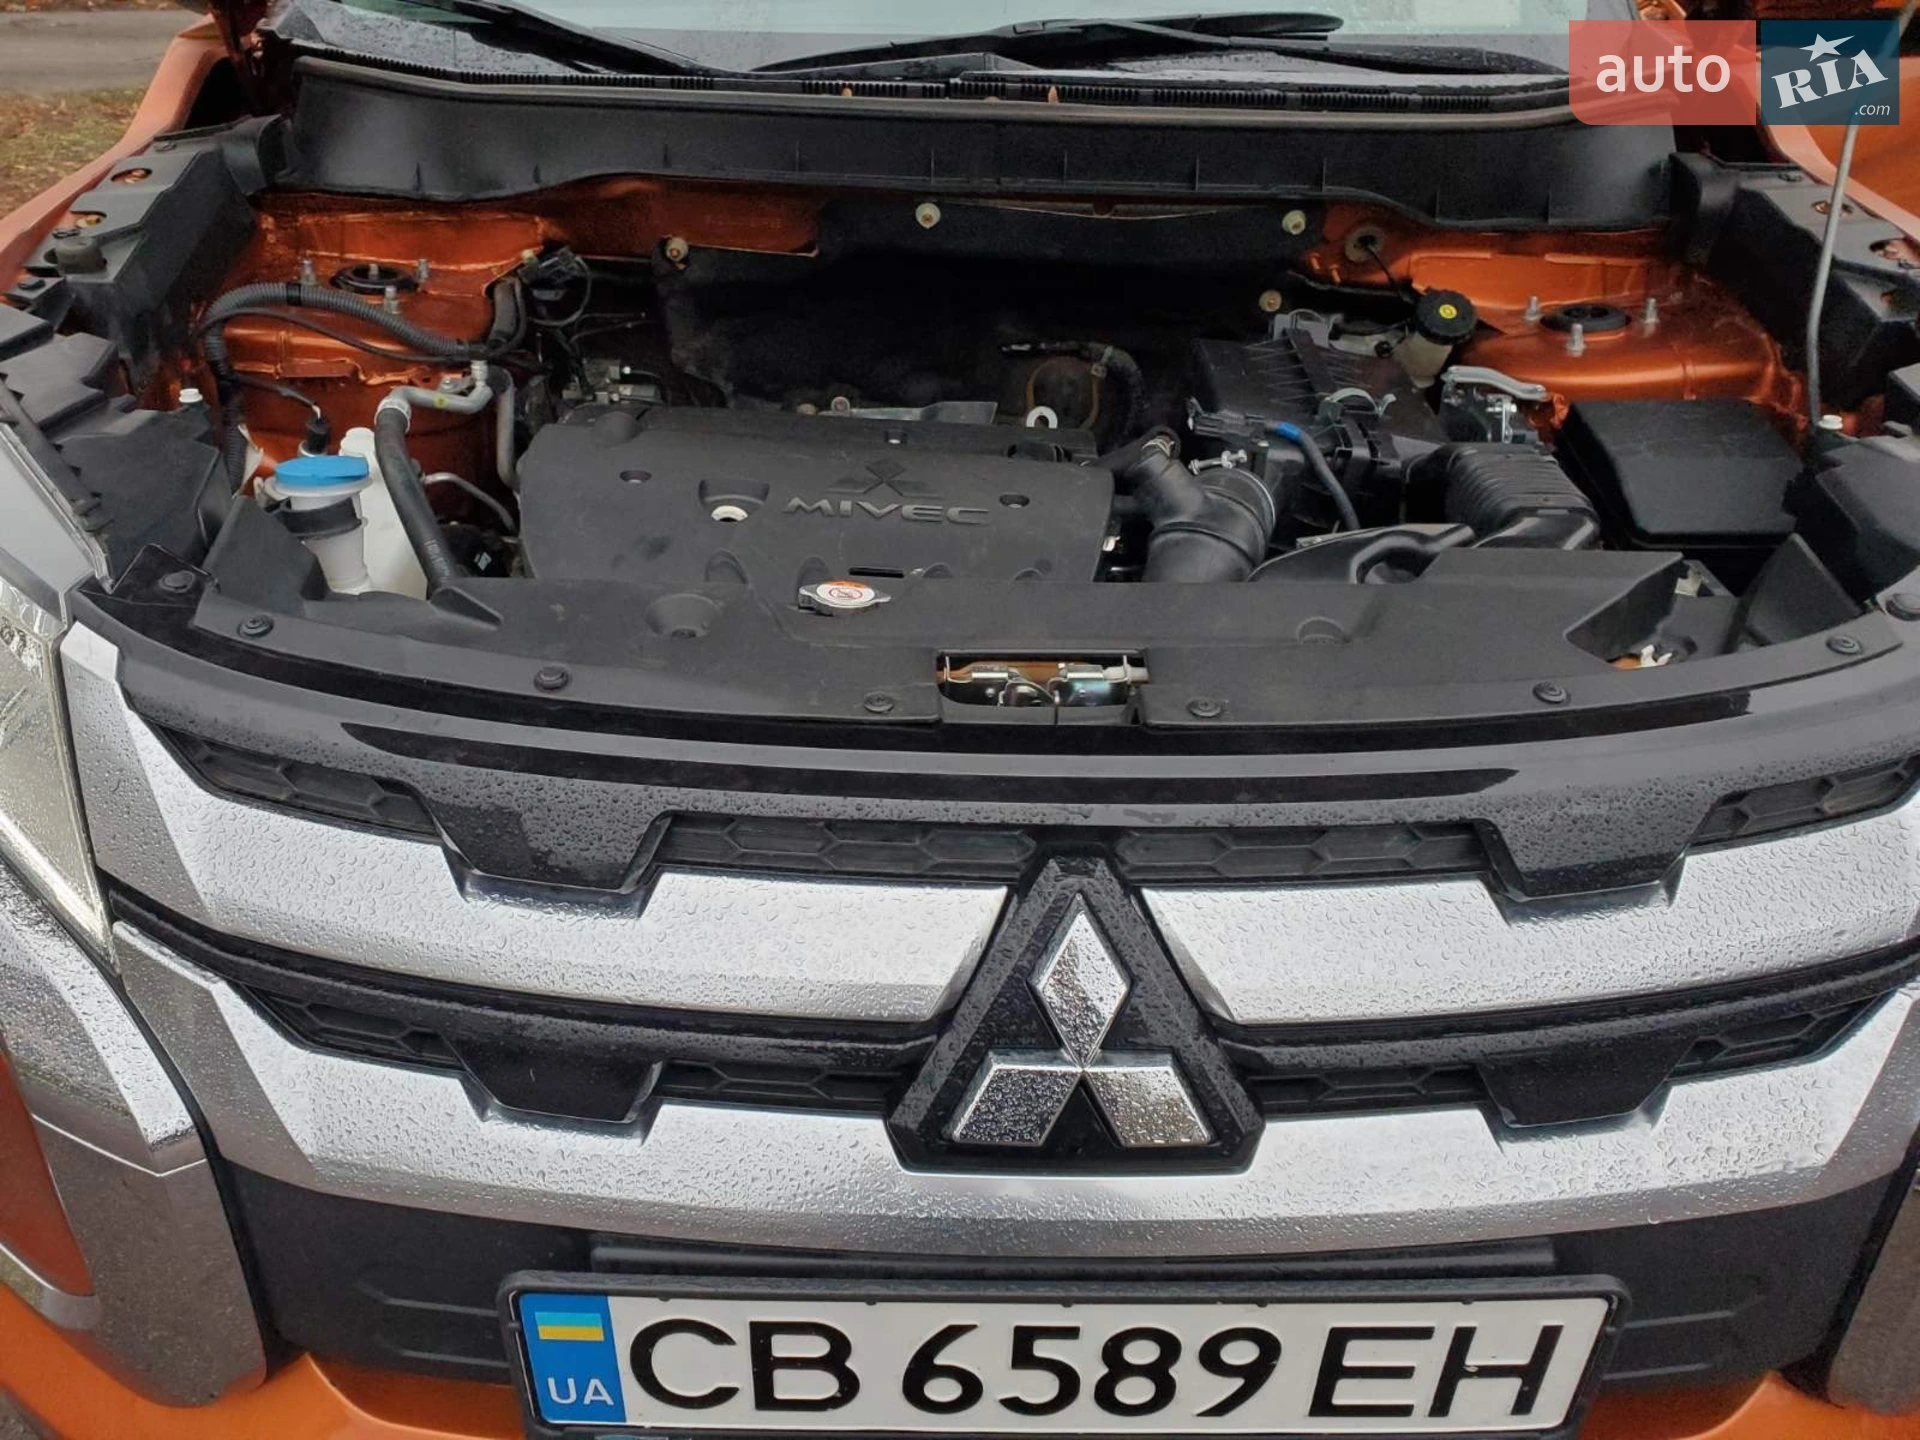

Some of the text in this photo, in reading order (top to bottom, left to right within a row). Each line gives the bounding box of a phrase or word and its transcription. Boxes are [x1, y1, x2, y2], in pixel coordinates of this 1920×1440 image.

[782, 497, 990, 525] MIVEC
[629, 1317, 1565, 1418] CB 6589 EH
[547, 1377, 615, 1406] UA
